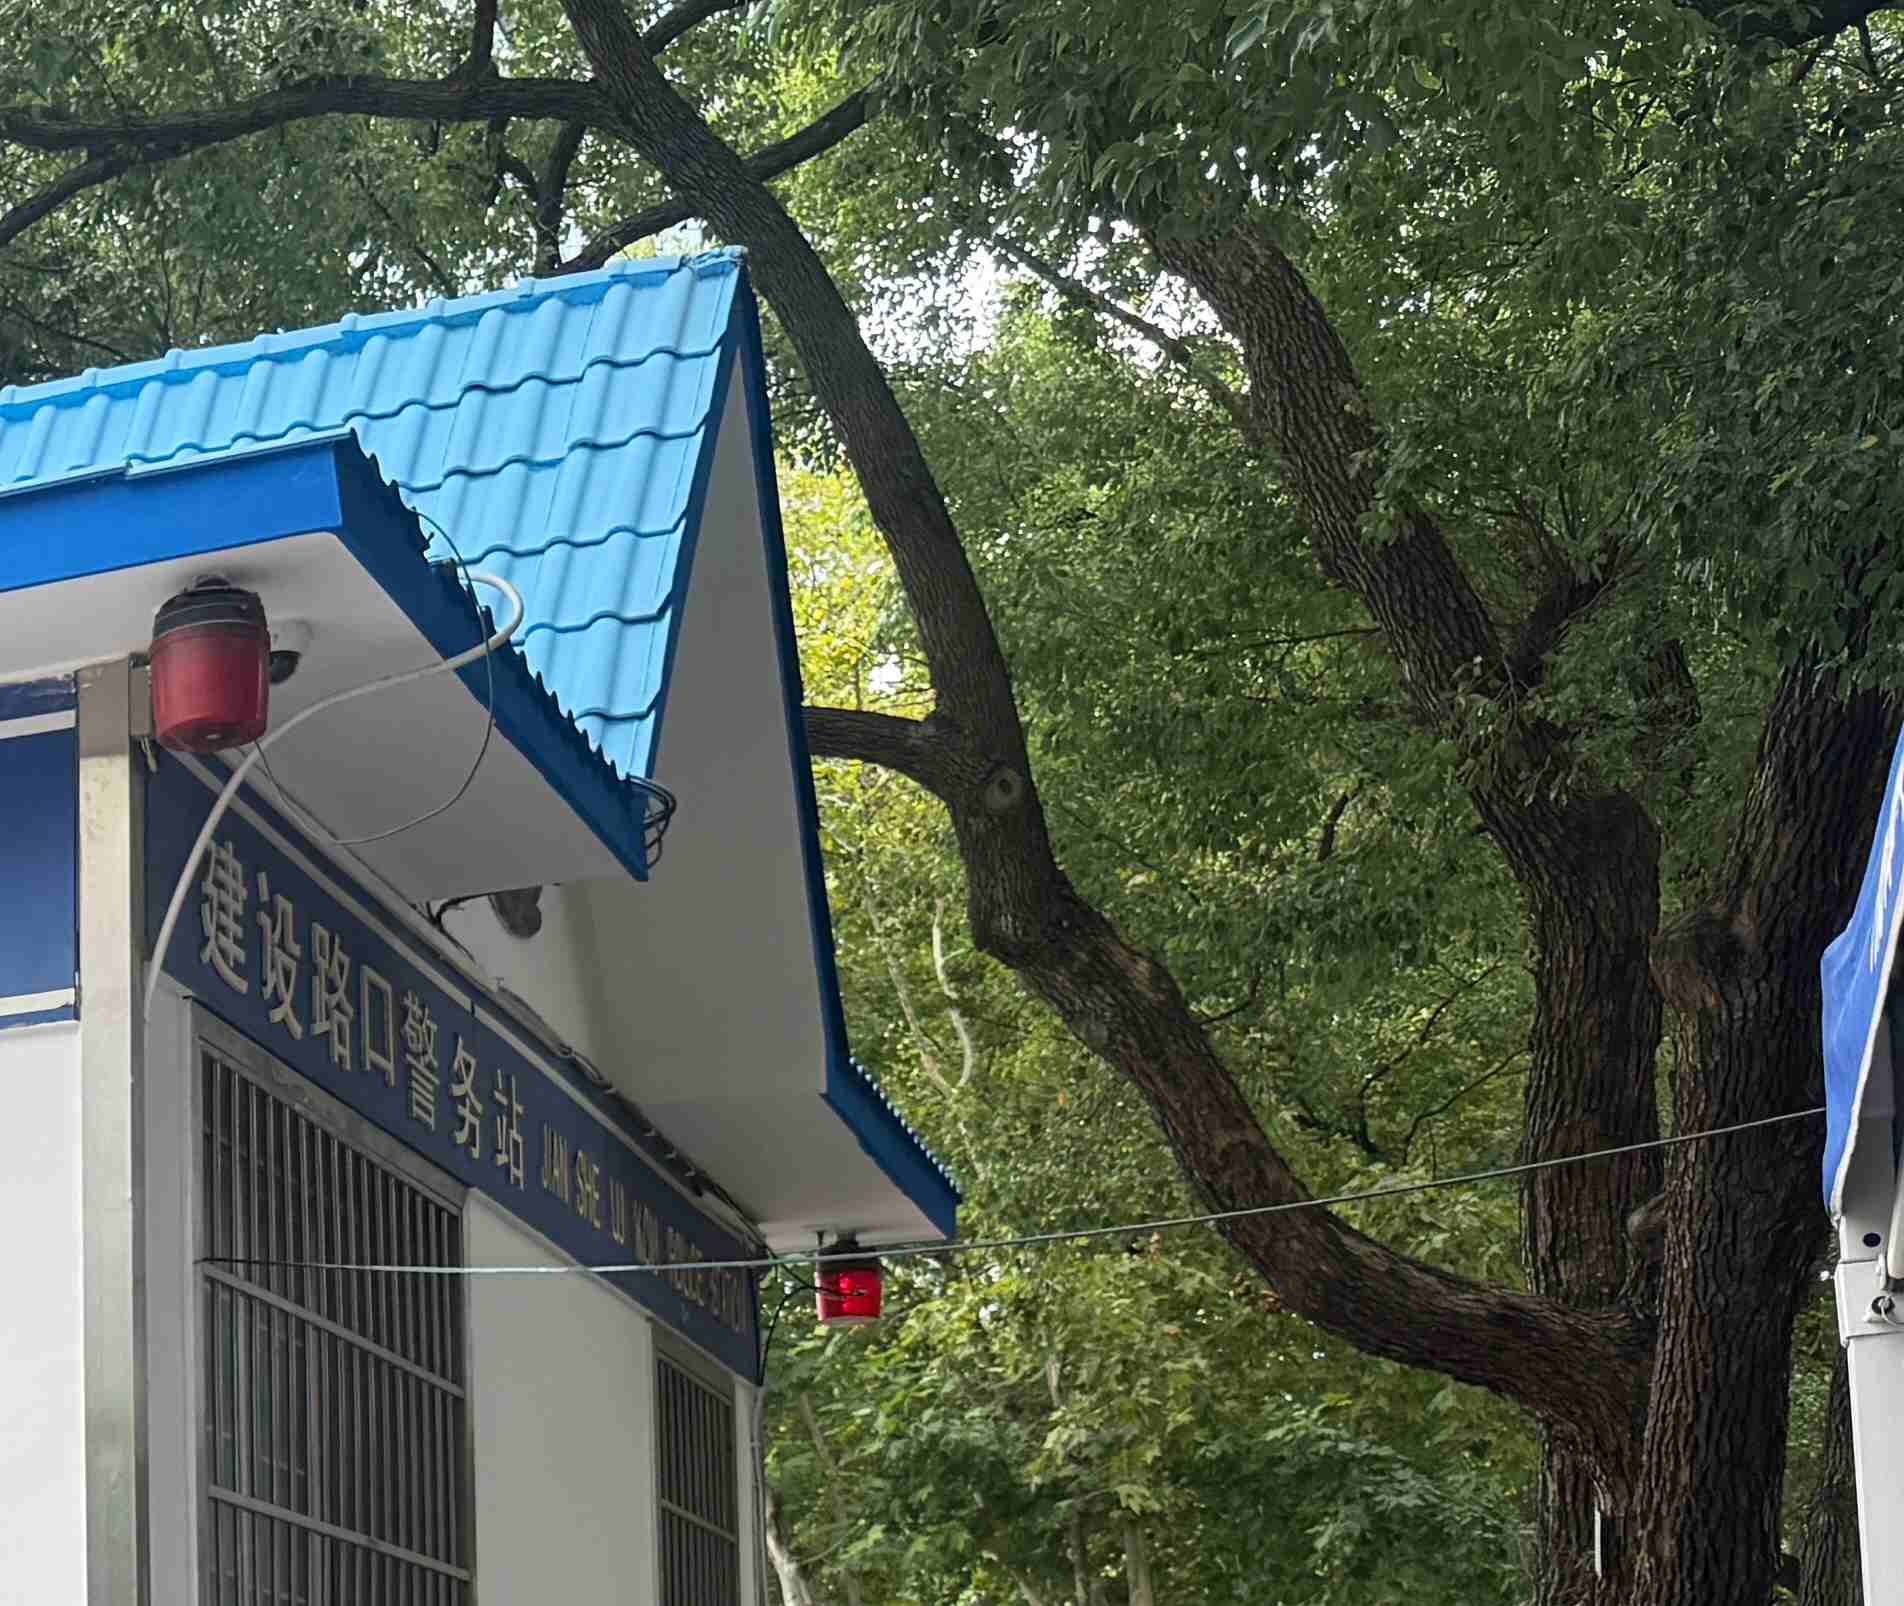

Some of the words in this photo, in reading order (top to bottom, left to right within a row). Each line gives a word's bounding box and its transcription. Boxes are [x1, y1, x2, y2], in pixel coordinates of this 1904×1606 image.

[201, 840, 525, 1192] 建设路口警务站
